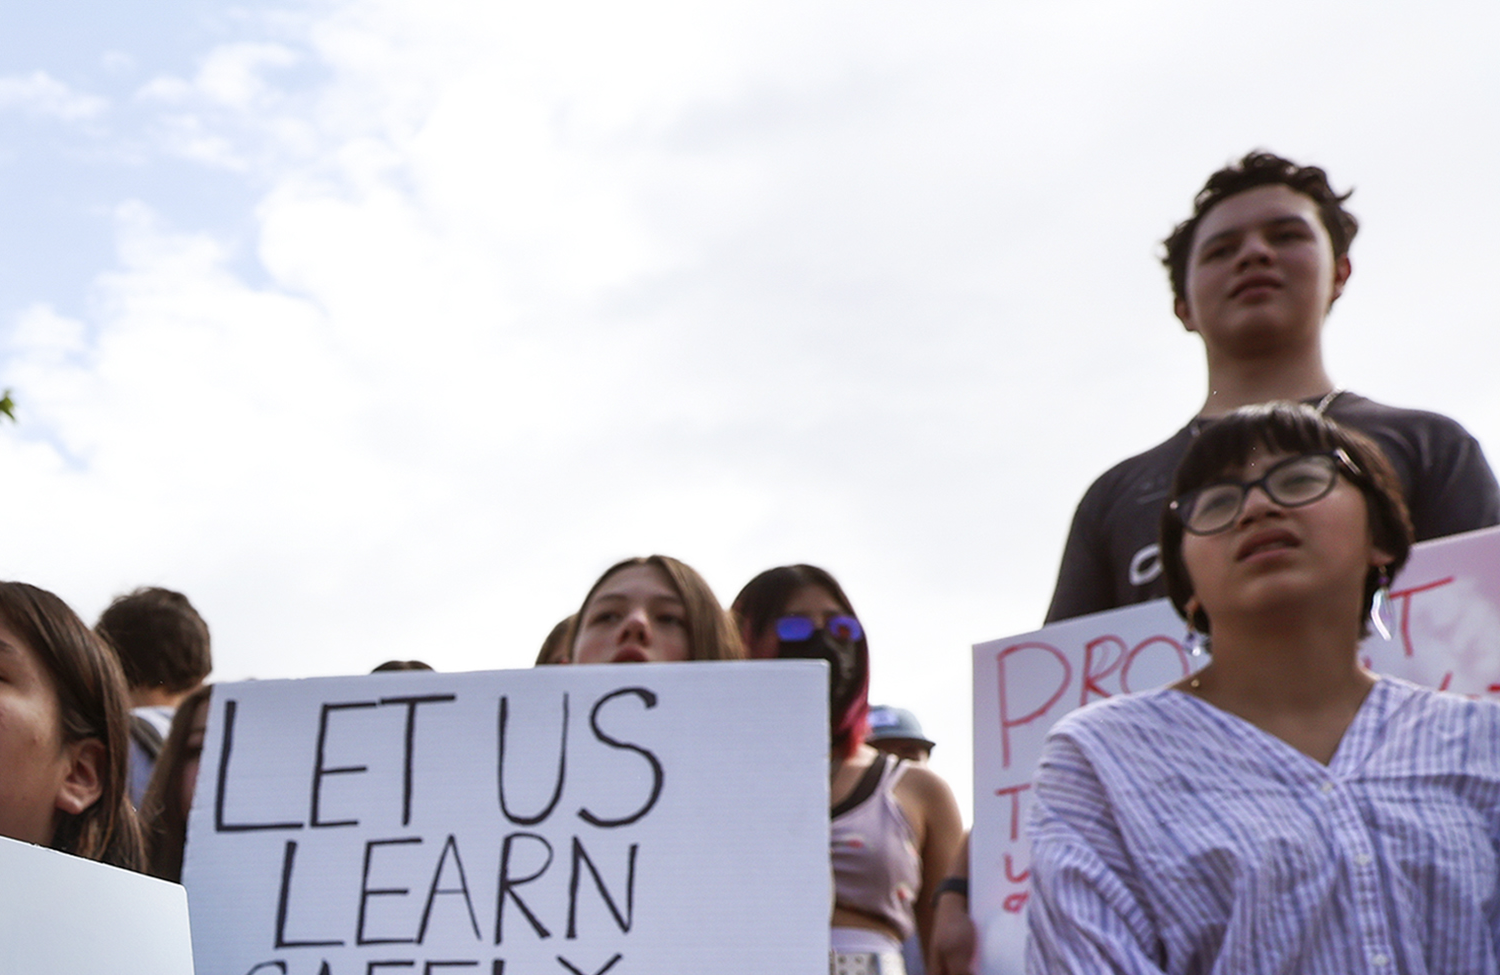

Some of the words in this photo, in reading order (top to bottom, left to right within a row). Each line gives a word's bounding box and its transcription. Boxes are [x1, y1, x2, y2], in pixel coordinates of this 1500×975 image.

[213, 693, 457, 833] LET
[497, 686, 665, 829] US
[274, 832, 638, 950] LEARN
